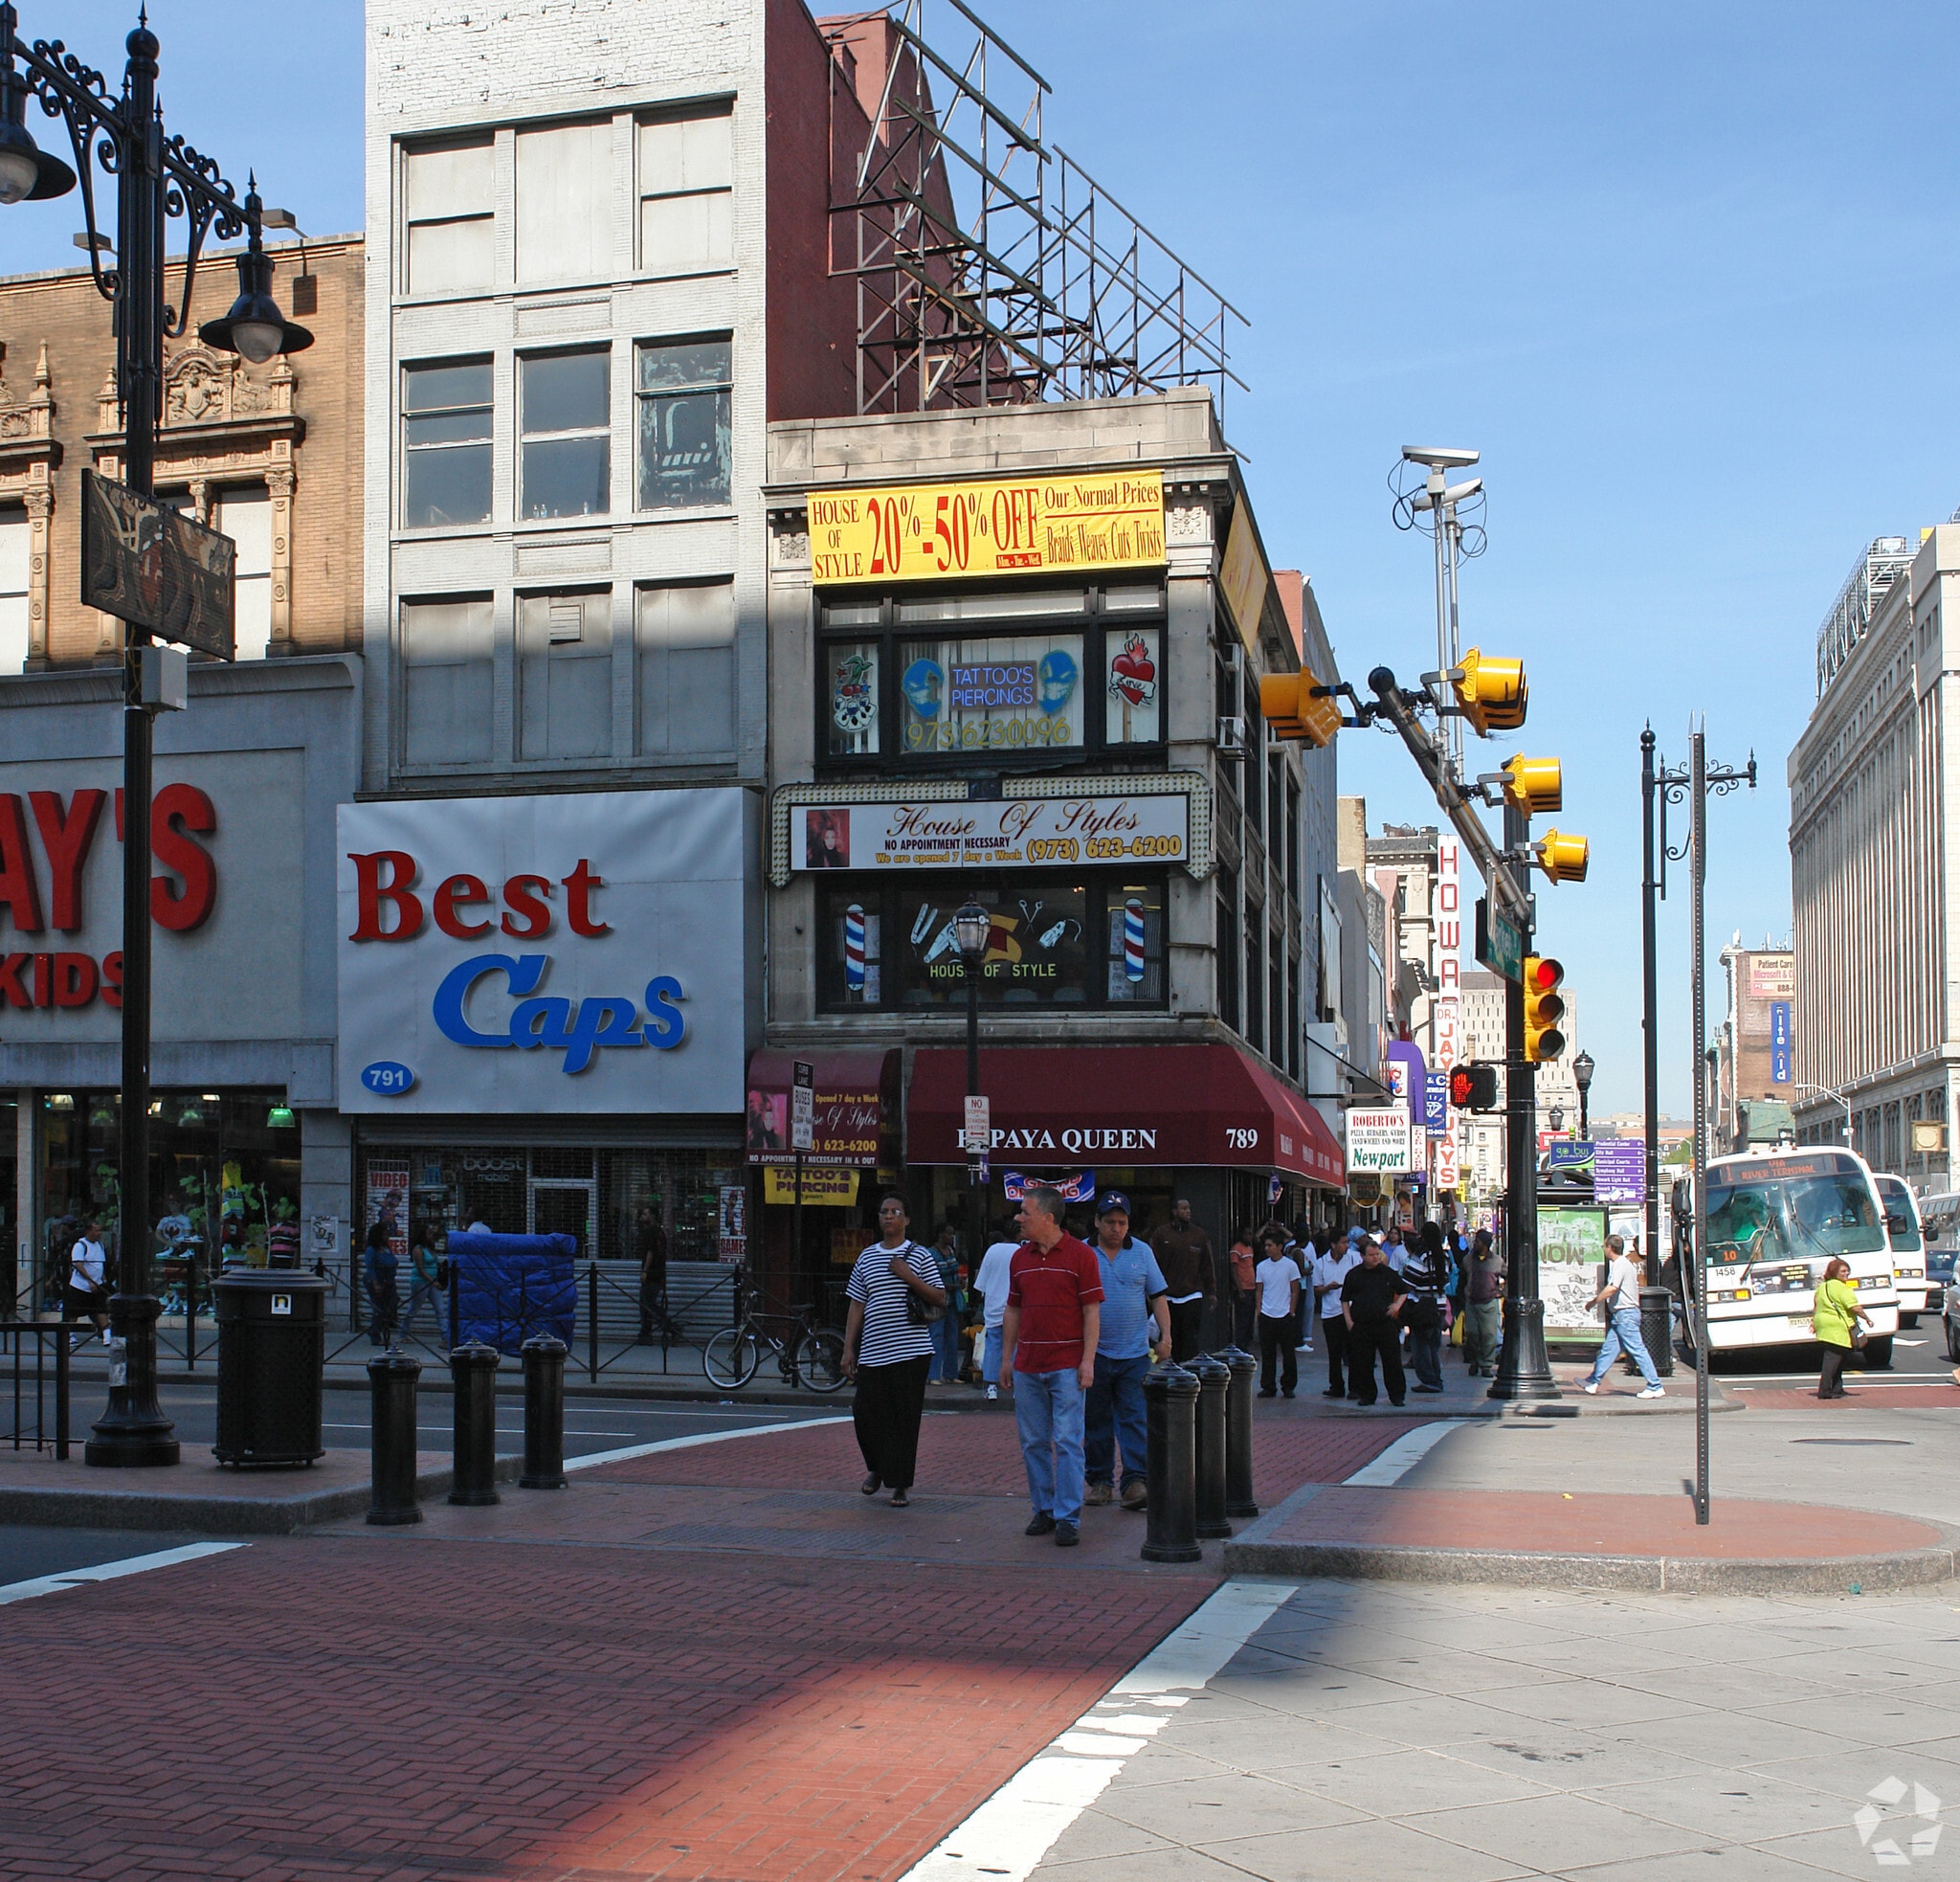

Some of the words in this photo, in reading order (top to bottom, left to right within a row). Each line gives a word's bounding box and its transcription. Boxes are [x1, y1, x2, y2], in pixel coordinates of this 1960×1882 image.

[1044, 486, 1070, 509] Our
[1073, 482, 1119, 508] Normal
[1123, 481, 1160, 504] Prices
[813, 499, 859, 526] HOUSE
[991, 487, 1040, 551] OFF
[828, 528, 842, 549] OF
[1047, 524, 1075, 564] Braids
[1077, 523, 1107, 562] Weaves
[1111, 521, 1131, 561] Cuts
[1134, 518, 1162, 559] Twists
[814, 552, 863, 579] STYLE
[952, 665, 1035, 686] TATTOO'S
[951, 685, 1035, 707] PIERCINGS
[886, 806, 977, 837] House
[999, 802, 1046, 840] Of
[1056, 800, 1141, 842] Styles
[884, 840, 898, 851] NO
[901, 838, 961, 851] APPOINTMENT
[964, 837, 1011, 849] NECESSARY
[1026, 838, 1080, 863] (973)
[1085, 835, 1182, 859] 623-6200
[876, 852, 891, 864] We
[893, 853, 910, 863] are
[913, 852, 950, 865] opened
[952, 851, 959, 863] 7
[963, 851, 982, 863] day
[985, 853, 992, 862] a
[994, 850, 1023, 862] Week
[346, 850, 611, 942] Best
[1438, 844, 1460, 1005] HOWA
[930, 964, 967, 977] HOUS
[984, 964, 1001, 977] OF
[1013, 963, 1057, 977] STYLE
[1757, 959, 1778, 969] Patient
[1780, 959, 1793, 969] Care
[1754, 969, 1781, 978] Microsoft
[433, 953, 685, 1074] Caps
[1437, 1008, 1456, 1020] DR.
[369, 1069, 405, 1087] 791
[795, 1089, 811, 1106] BUSES
[815, 1094, 837, 1104] Opened
[838, 1094, 843, 1103] 7
[844, 1094, 855, 1104] day
[970, 1099, 983, 1109] NO
[827, 1105, 844, 1131] Of
[846, 1106, 878, 1132] Styles
[1352, 1114, 1405, 1128] ROBERTO'S
[823, 1139, 878, 1153] 623-6200
[1060, 1128, 1157, 1154] QUEEN
[1225, 1128, 1258, 1150] 789
[1573, 1142, 1589, 1155] bus
[462, 1154, 525, 1172] boost
[748, 1154, 759, 1163] NO
[761, 1155, 806, 1164] APPOINTMT
[808, 1155, 843, 1164] NECESSARY
[845, 1156, 853, 1165] IN
[862, 1156, 876, 1165] OUT
[1352, 1148, 1406, 1171] Newport
[369, 1172, 409, 1188] VIDEO
[774, 1168, 851, 1181] TATOO'S
[1742, 1168, 1770, 1180] RIVER
[1771, 1164, 1816, 1178] TERMINAL
[1723, 1250, 1737, 1263] 10
[1715, 1267, 1736, 1277] 1458
